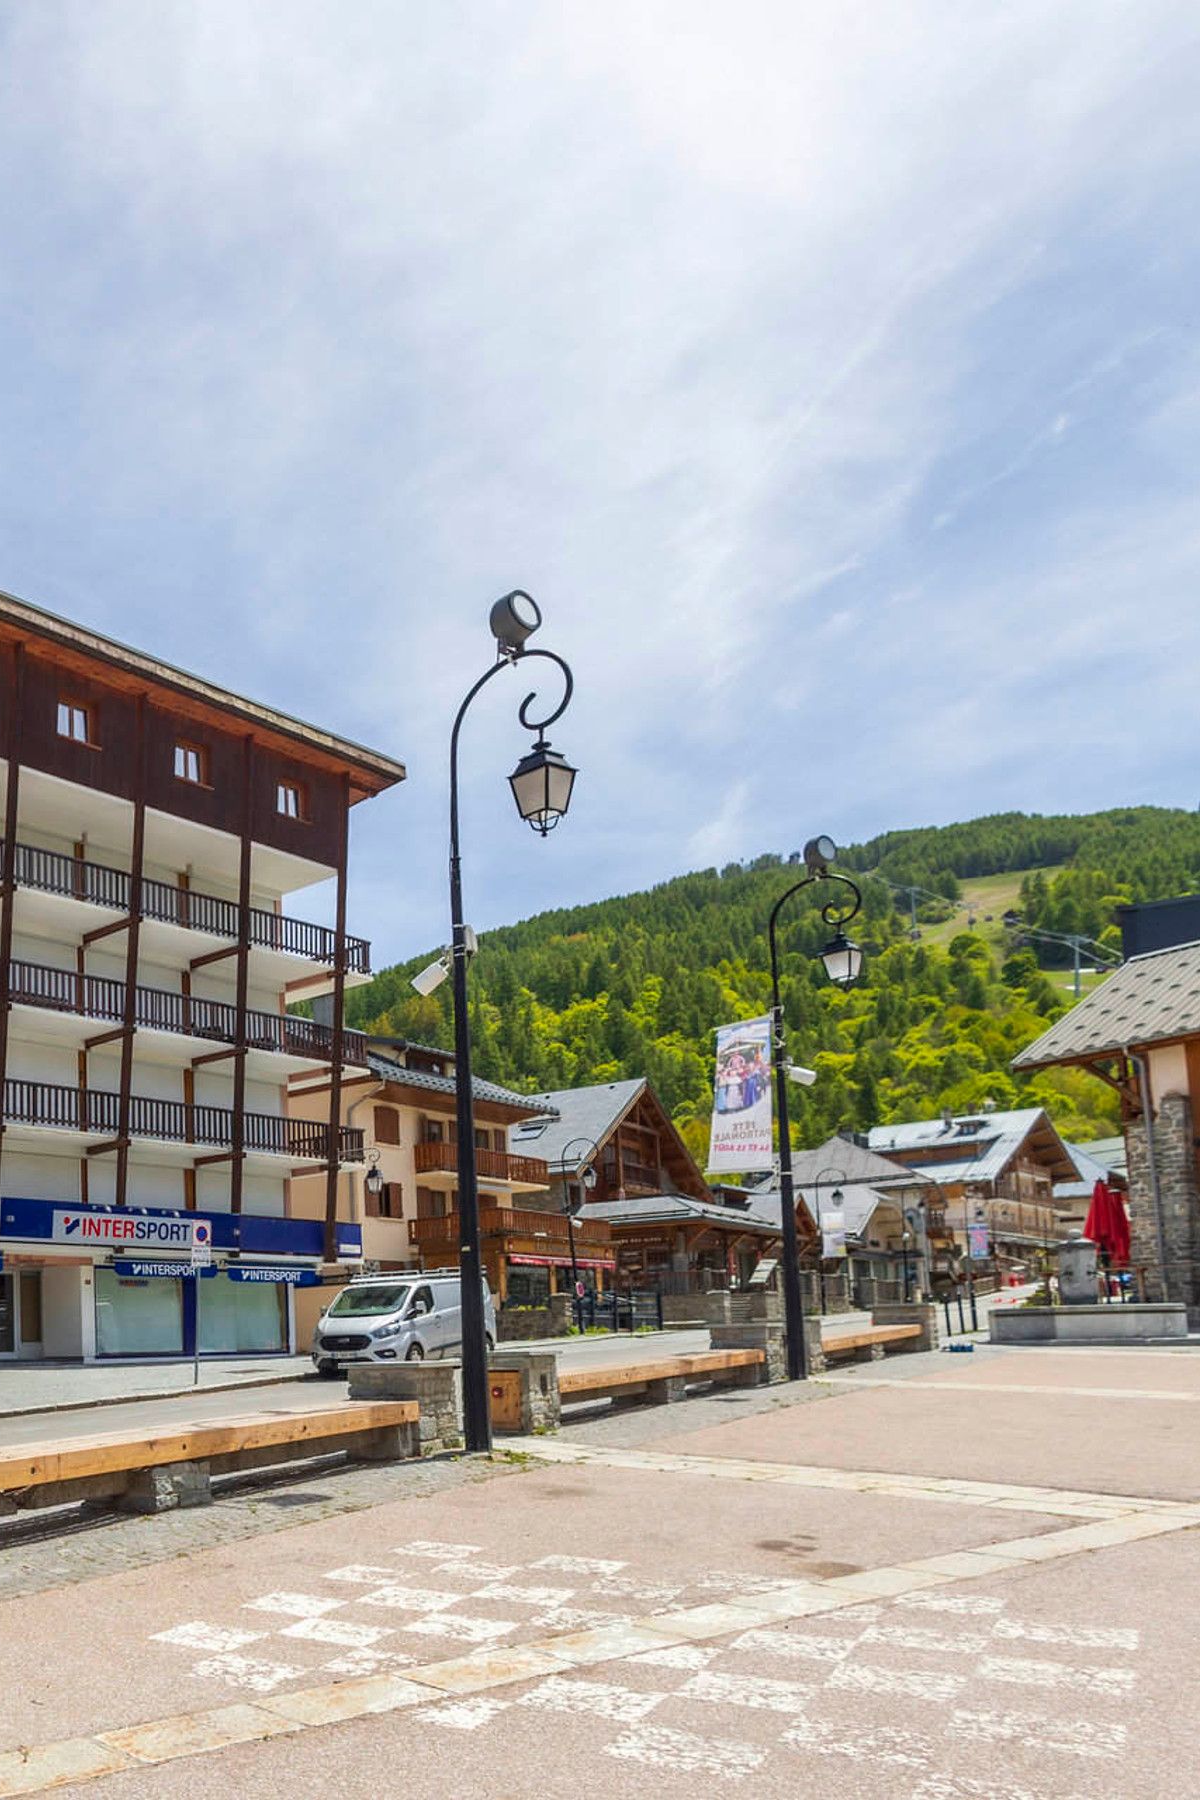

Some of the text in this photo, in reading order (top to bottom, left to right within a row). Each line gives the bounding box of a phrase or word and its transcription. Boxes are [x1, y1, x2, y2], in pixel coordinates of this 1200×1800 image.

[82, 1216, 191, 1242] INTERSPORT
[142, 1264, 197, 1277] INTERSPOR
[250, 1269, 302, 1282] INTERSPORT
